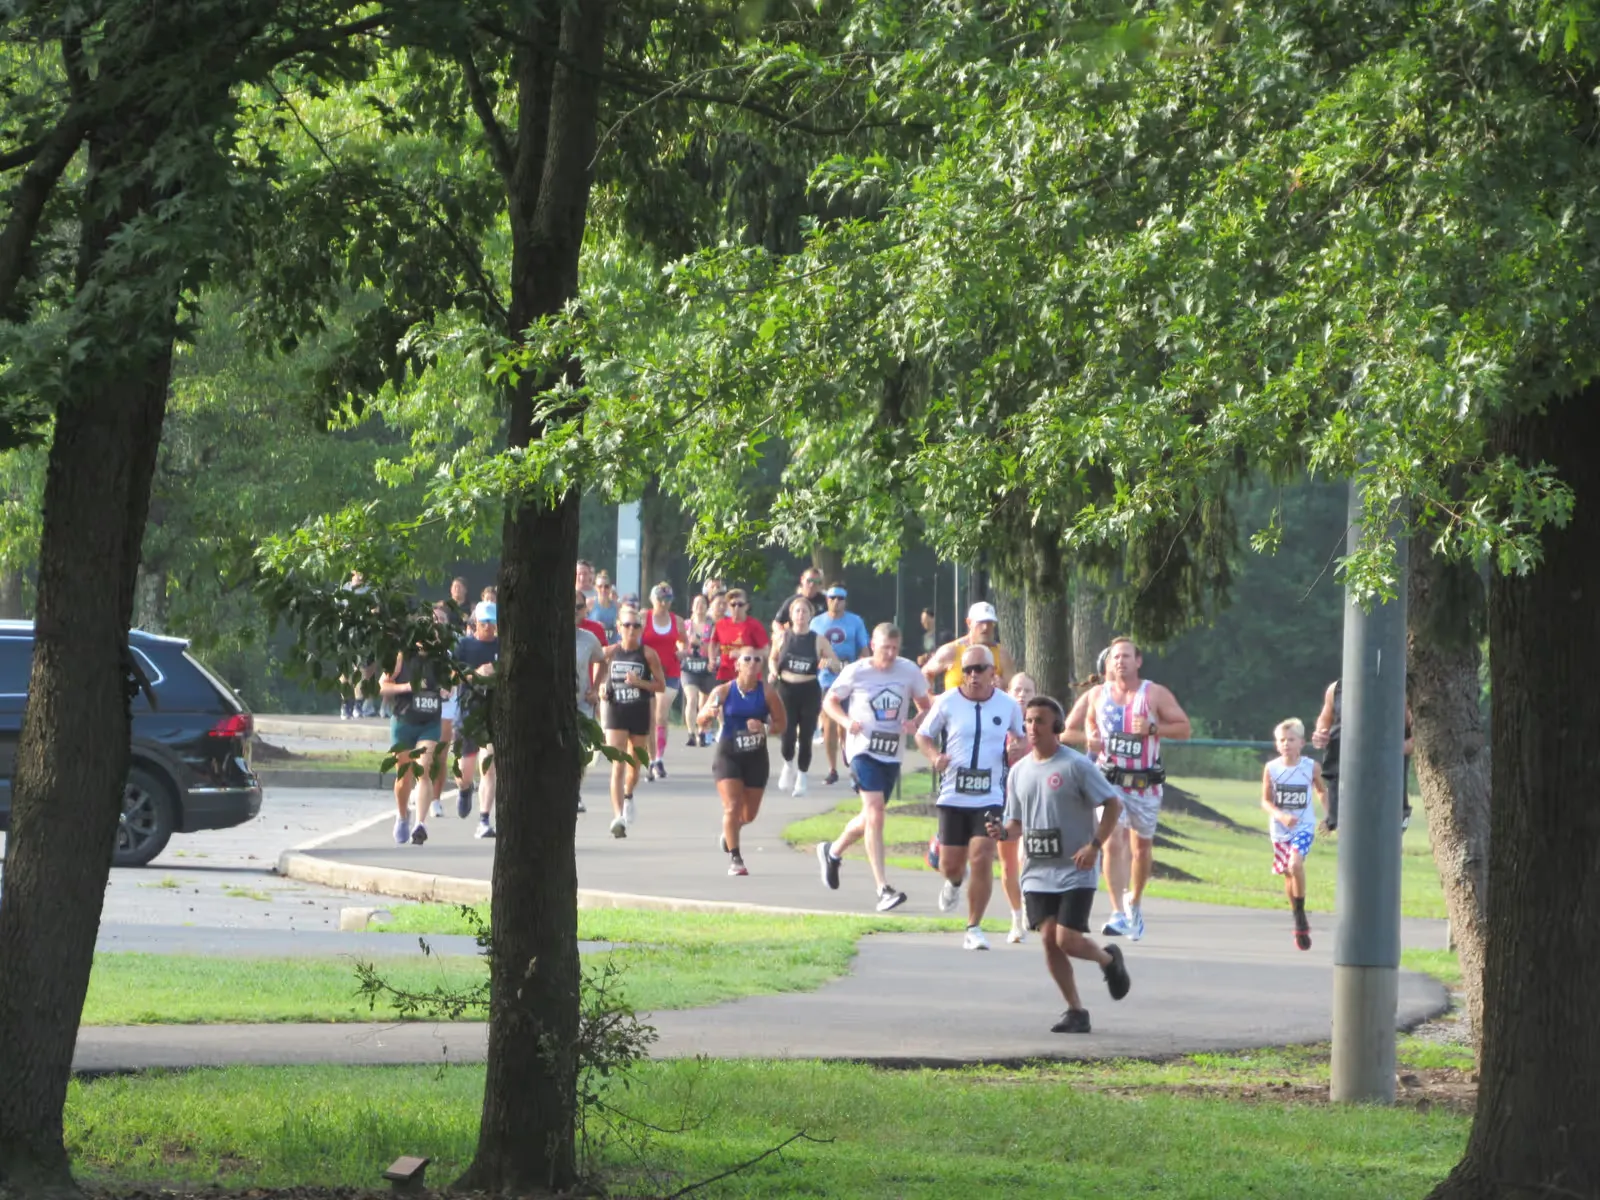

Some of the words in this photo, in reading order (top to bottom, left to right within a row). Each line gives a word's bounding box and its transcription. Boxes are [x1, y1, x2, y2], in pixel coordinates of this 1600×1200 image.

[415, 697, 438, 709] 1204
[872, 738, 898, 753] 1117
[1111, 738, 1142, 755] 1219
[1276, 791, 1307, 805] 1220
[1027, 837, 1059, 853] 1211
